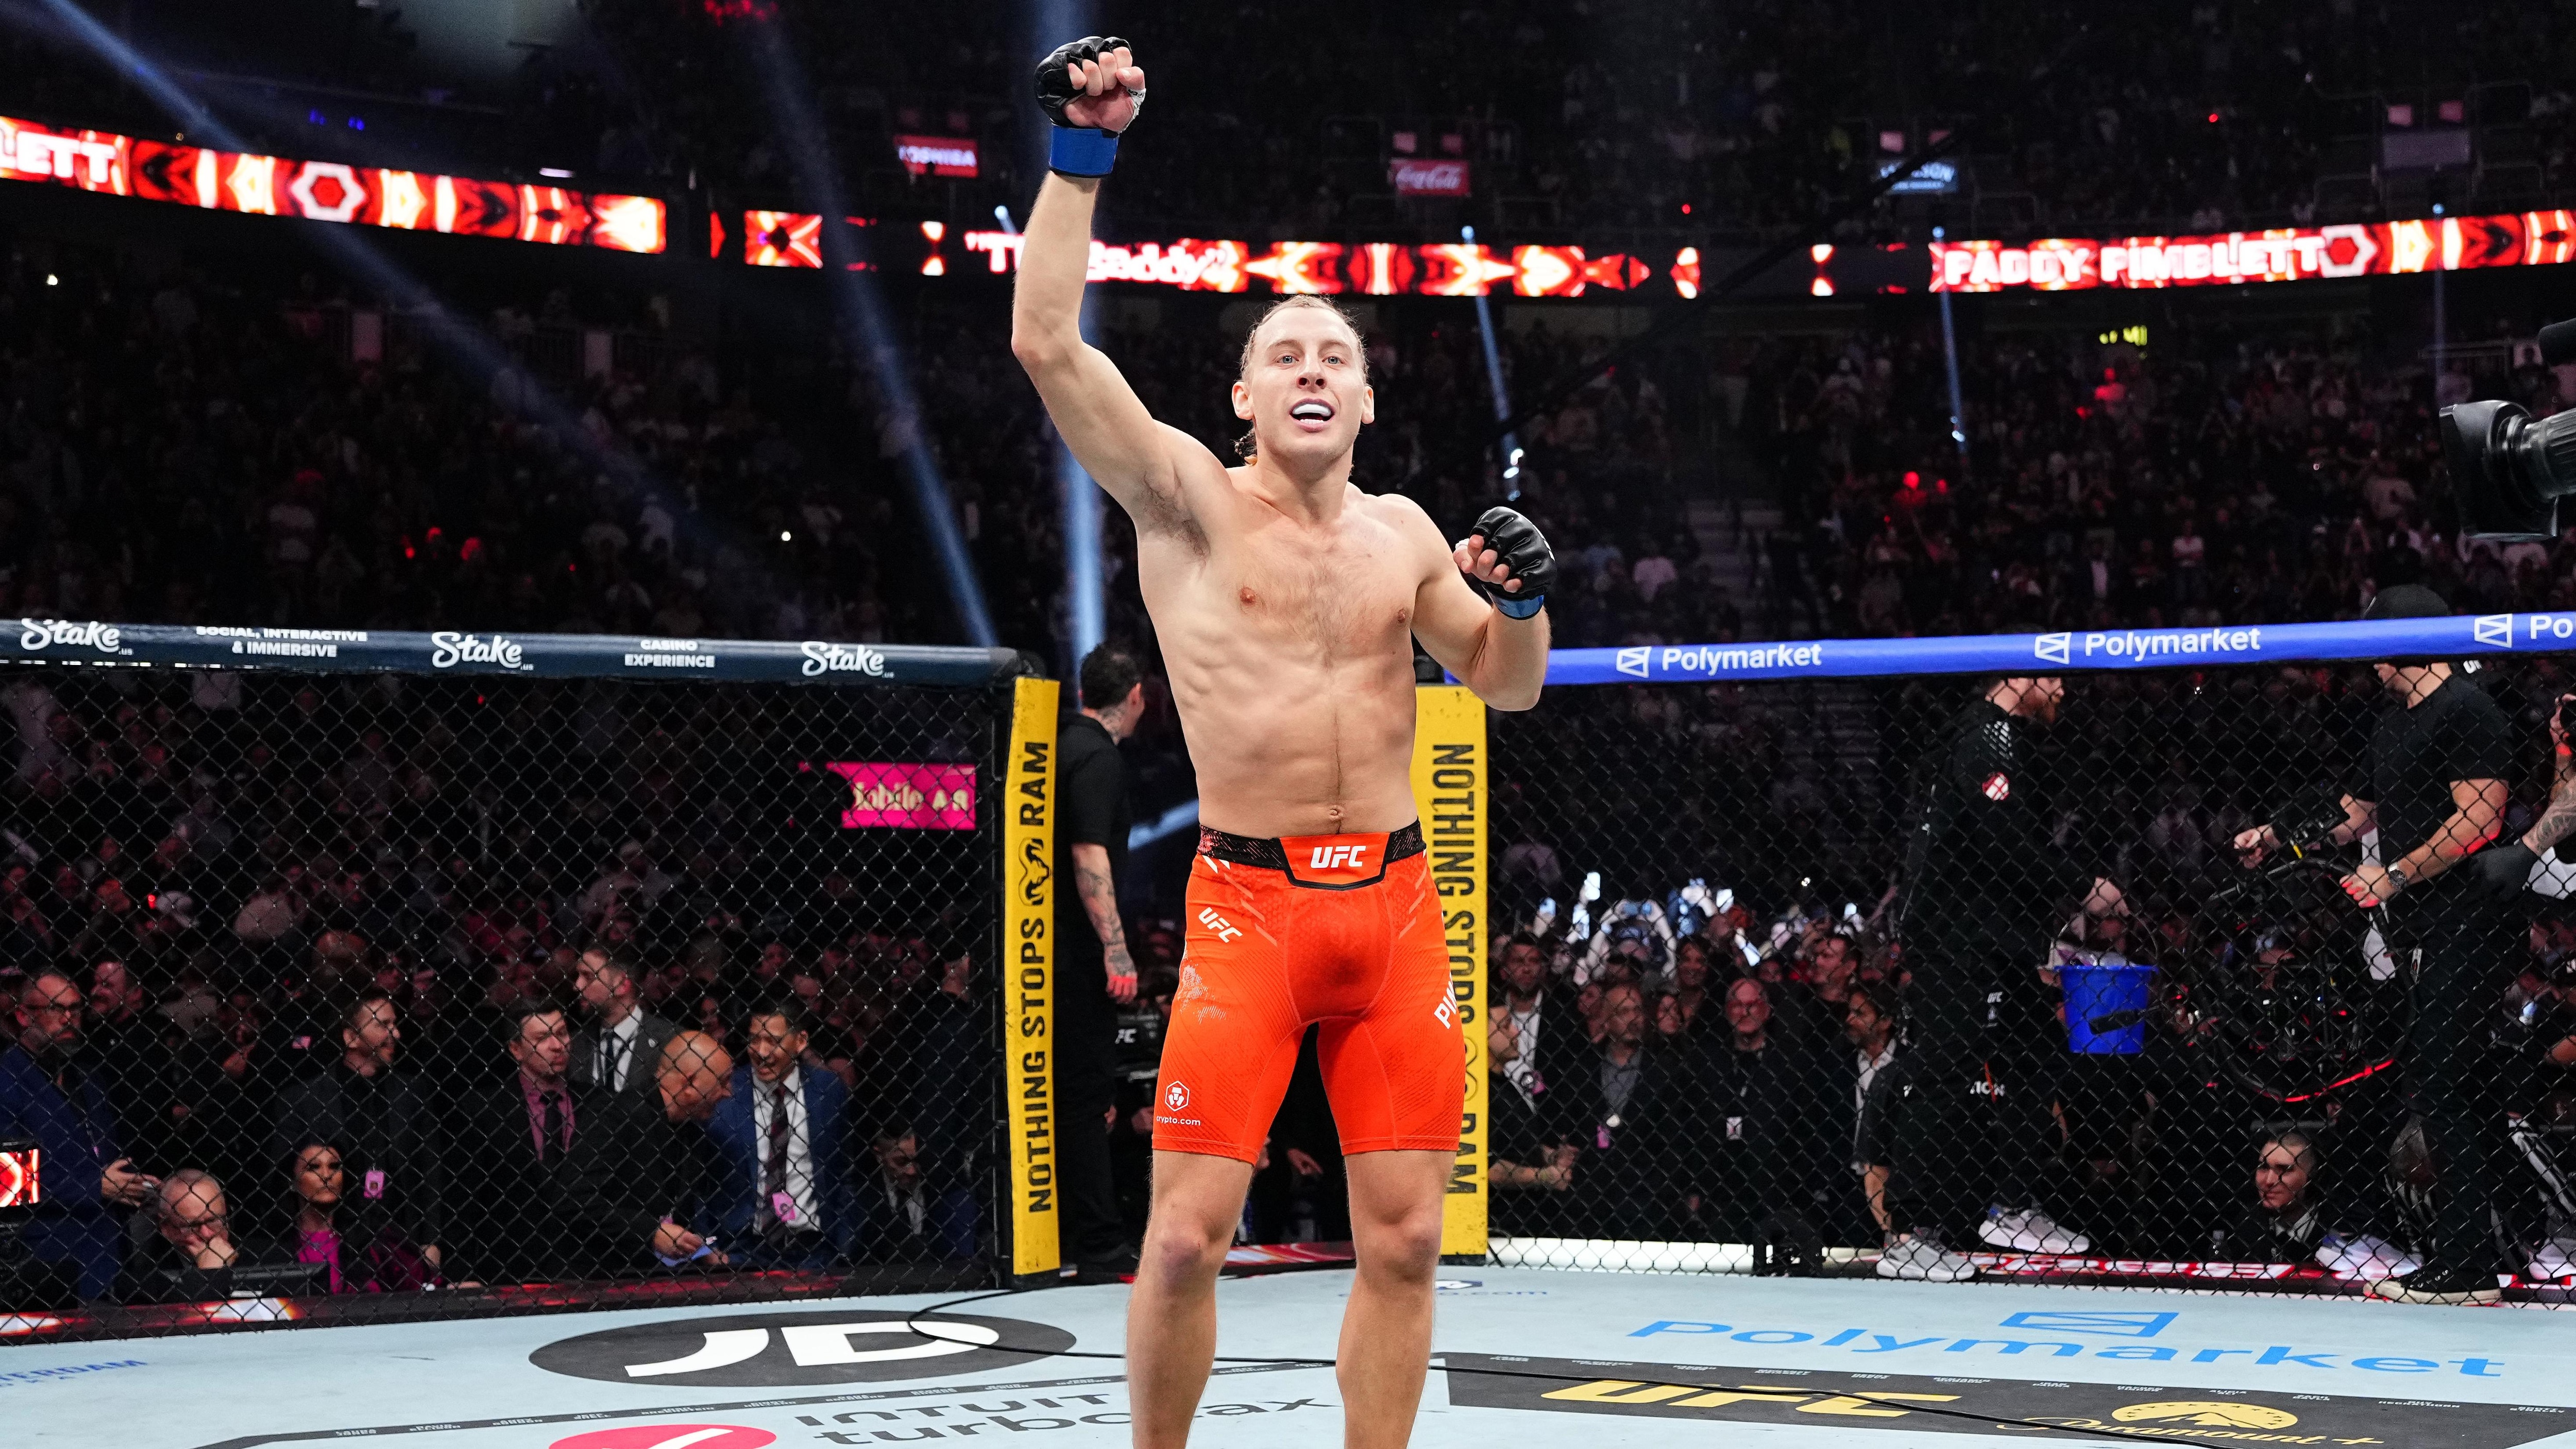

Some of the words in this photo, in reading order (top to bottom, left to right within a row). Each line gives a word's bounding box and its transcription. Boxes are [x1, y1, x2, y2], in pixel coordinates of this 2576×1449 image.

[0, 131, 117, 183] LETT
[1944, 247, 2090, 285] PADDY
[2100, 236, 2326, 283] PIMBLETT
[21, 618, 121, 653] Stake
[196, 625, 261, 639] SOCIAL,
[263, 628, 368, 642] INTERACTIVE
[640, 639, 698, 652] CASINO
[2085, 627, 2261, 662] Polymarket
[2530, 615, 2576, 640] Po
[232, 641, 243, 654] &
[247, 641, 338, 658] IMMERSIVE
[431, 631, 523, 669] Stake
[624, 653, 716, 669] EXPERIENCE
[801, 641, 885, 677] Stake
[1662, 643, 1822, 676] Polymarket
[1018, 741, 1049, 827] RAM
[1432, 744, 1475, 897] NOTHING
[1310, 845, 1367, 869] UFC
[1198, 907, 1243, 943] UFC
[1019, 916, 1046, 1038] STOPS
[1114, 1028, 1137, 1044] FC
[1022, 1050, 1052, 1213] NOTHING
[1156, 1115, 1201, 1126] crypto.com
[623, 1320, 1000, 1377] JD
[1626, 1320, 2506, 1377] Polymarket
[1540, 1379, 1963, 1418] UFC
[813, 1397, 1342, 1446] turboax
